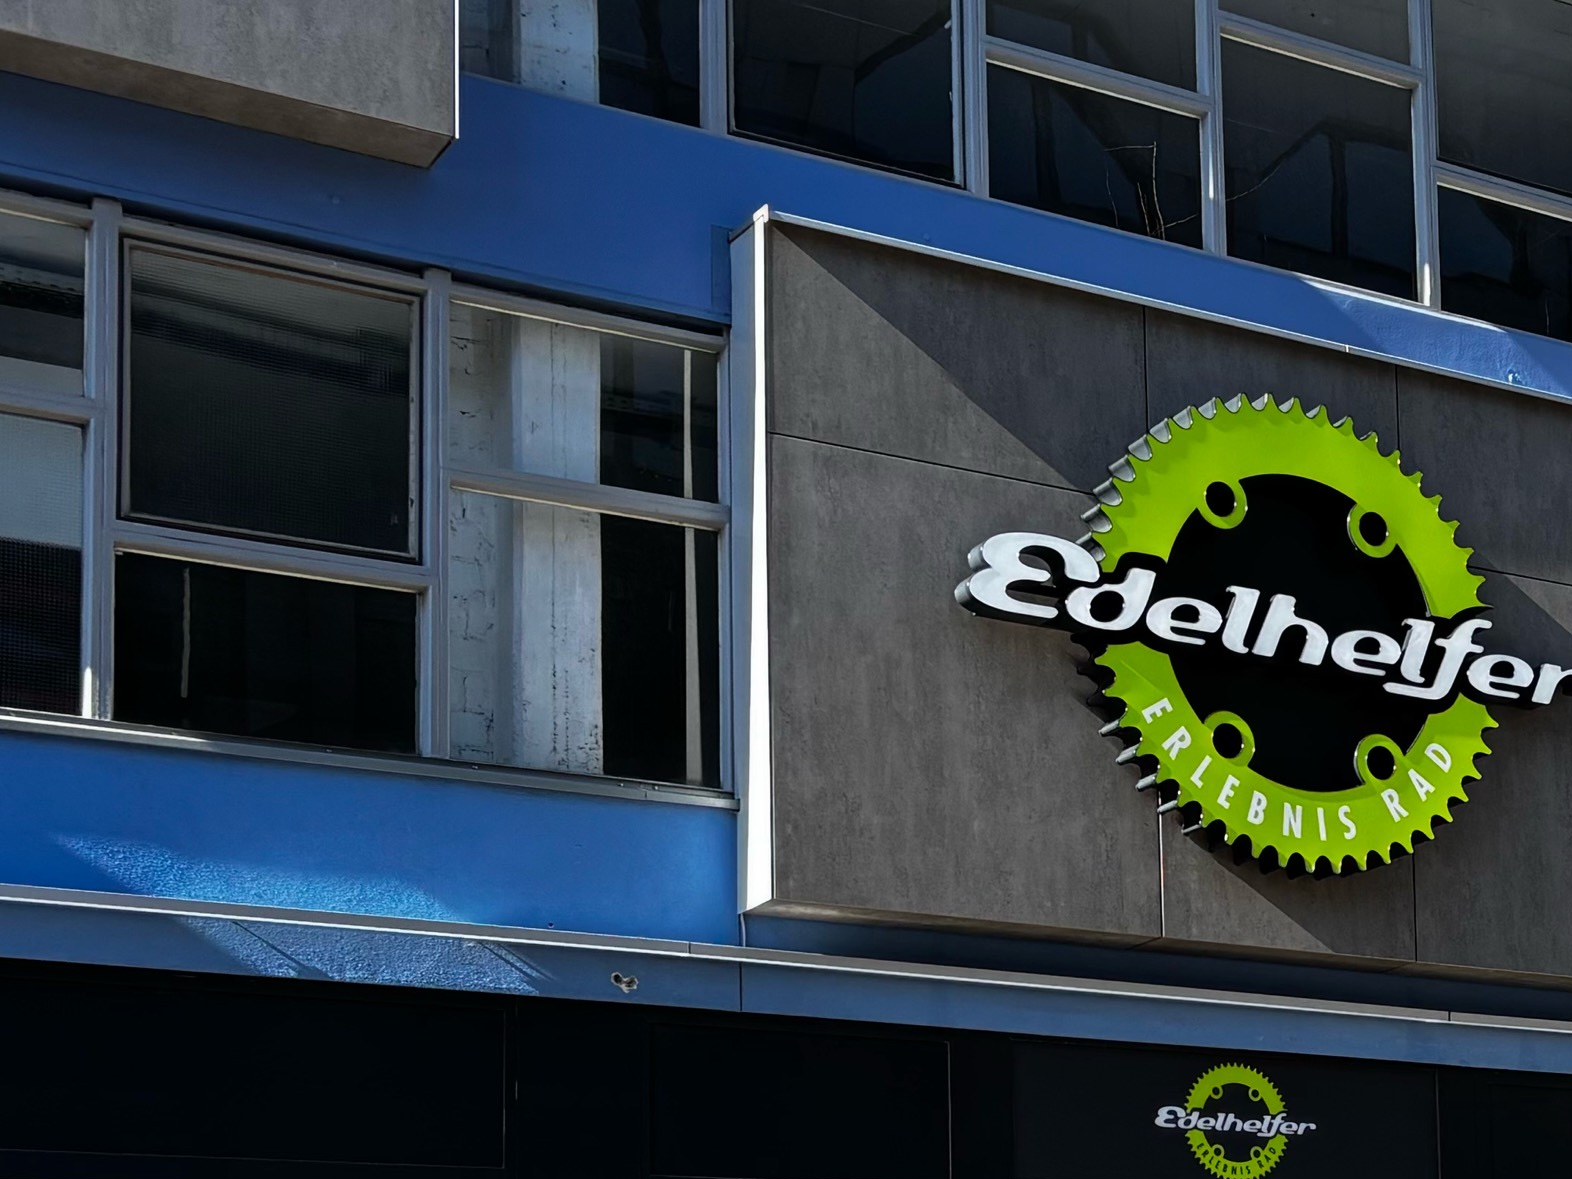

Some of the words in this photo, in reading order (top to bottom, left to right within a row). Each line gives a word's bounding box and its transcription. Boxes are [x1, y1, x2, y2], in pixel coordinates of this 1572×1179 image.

[1141, 697, 1358, 841] ERLEBNIS
[1386, 742, 1454, 824] RAD
[1154, 1105, 1317, 1138] Edelhelfer
[1196, 1142, 1252, 1175] ERLEBNIS
[1257, 1146, 1277, 1169] RAD
